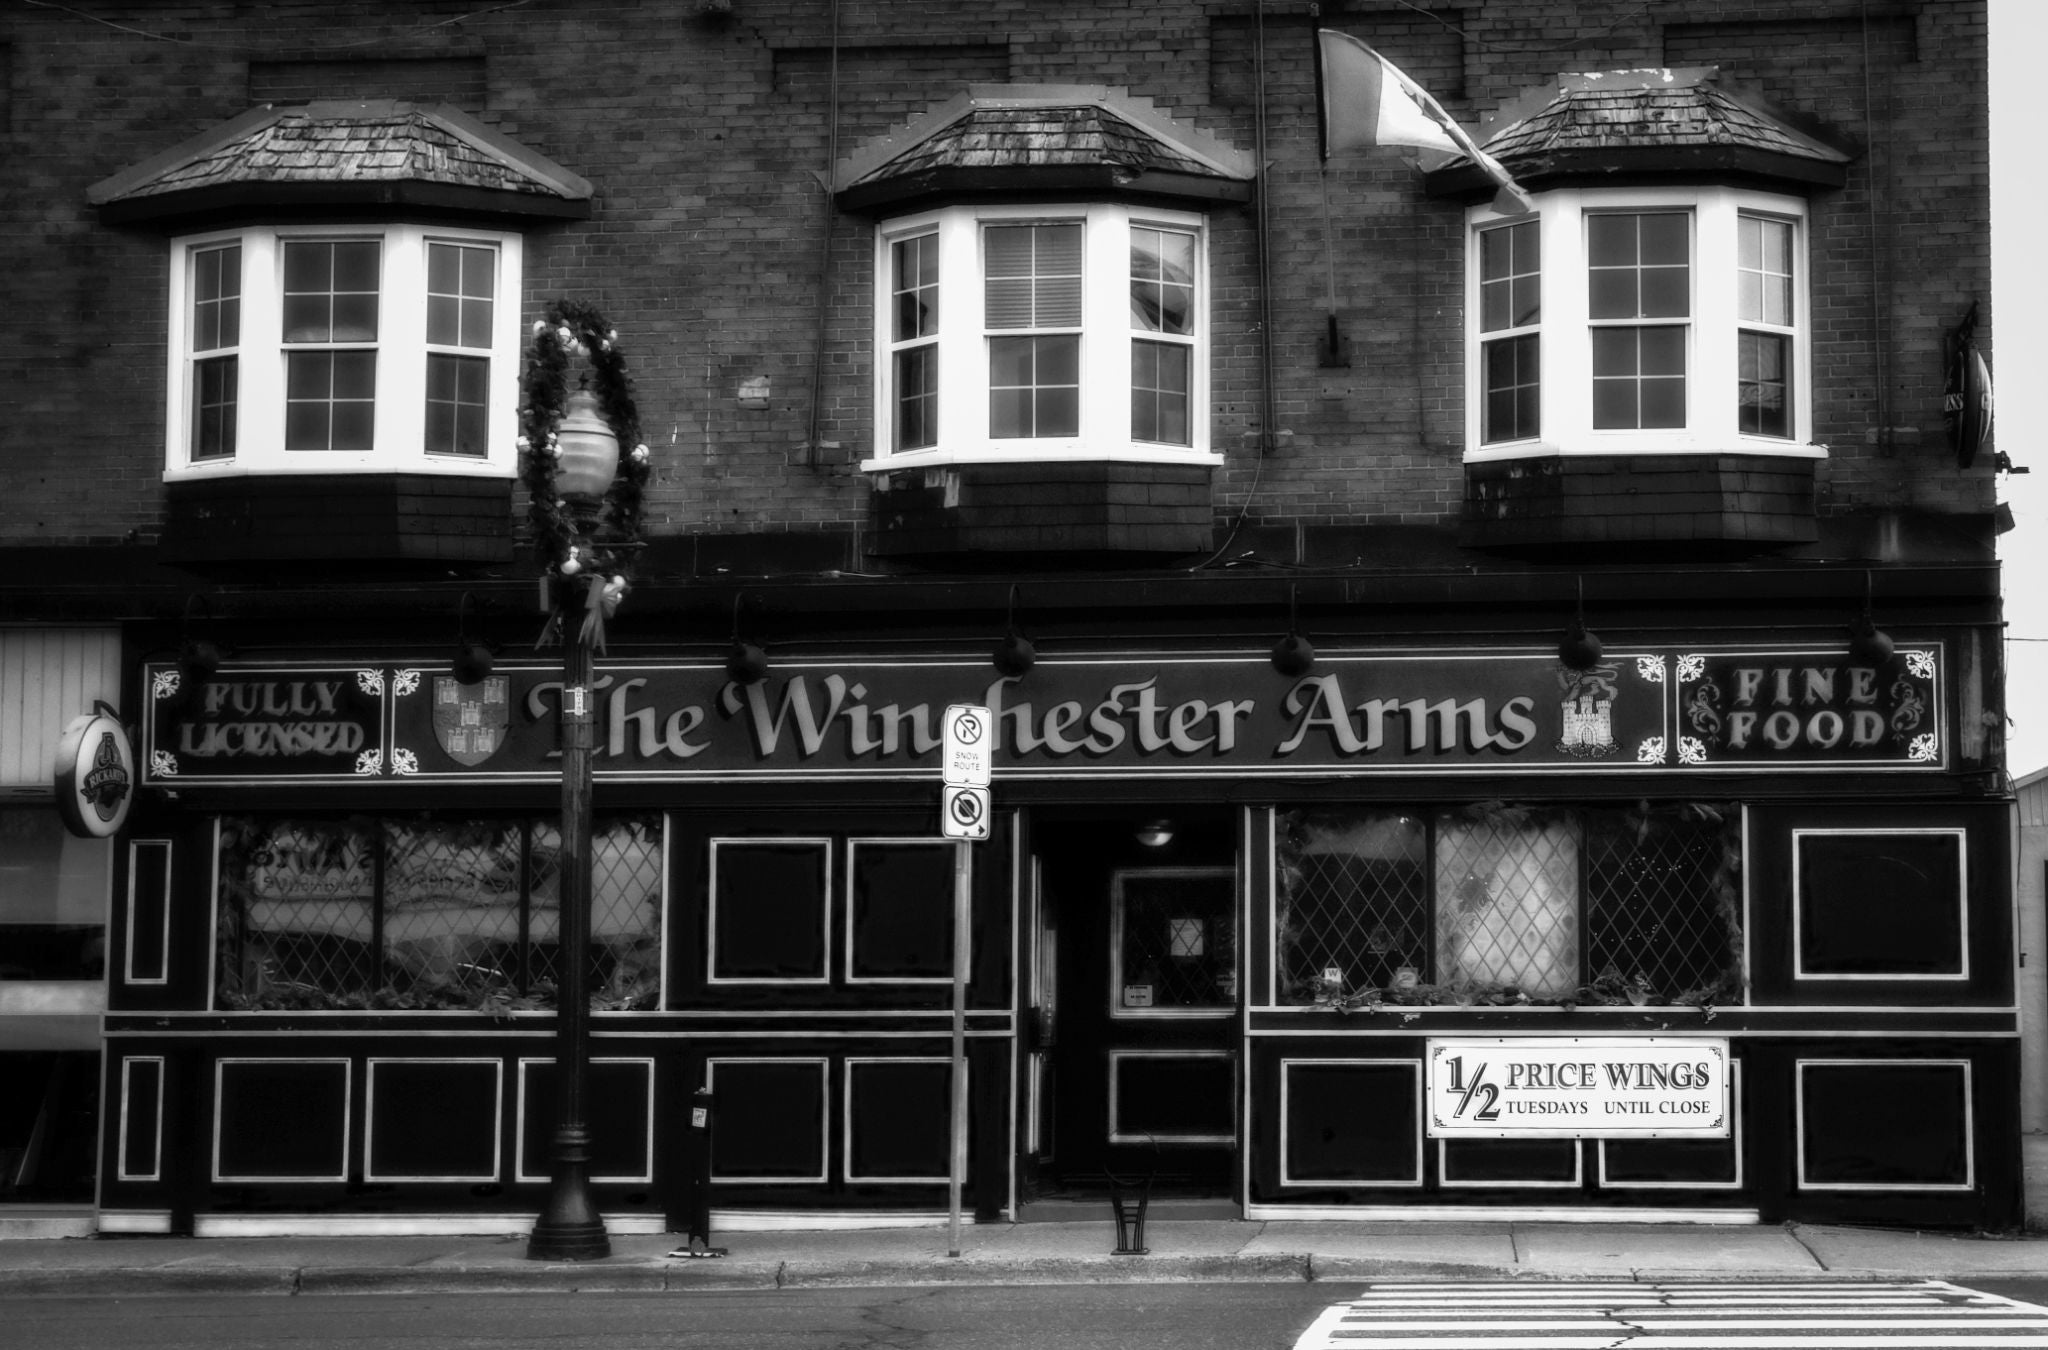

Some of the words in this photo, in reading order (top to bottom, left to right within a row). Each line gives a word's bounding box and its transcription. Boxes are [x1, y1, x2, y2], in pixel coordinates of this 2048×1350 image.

[203, 681, 343, 716] FULLY
[1733, 667, 1878, 706] FINE
[718, 672, 1256, 758] Winhester
[1277, 671, 1539, 754] Arms
[1726, 710, 1885, 749] FOOD
[178, 721, 365, 757] LICENSED
[955, 751, 979, 760] SNOW
[954, 761, 981, 771] ROUTE
[1446, 1056, 1501, 1121] 1/2
[1504, 1062, 1597, 1090] PRICE
[1602, 1062, 1711, 1090] WINGS
[1506, 1101, 1589, 1114] TUESDAYS
[1604, 1101, 1655, 1114] UNTIL
[1658, 1101, 1711, 1114] CLOSE
